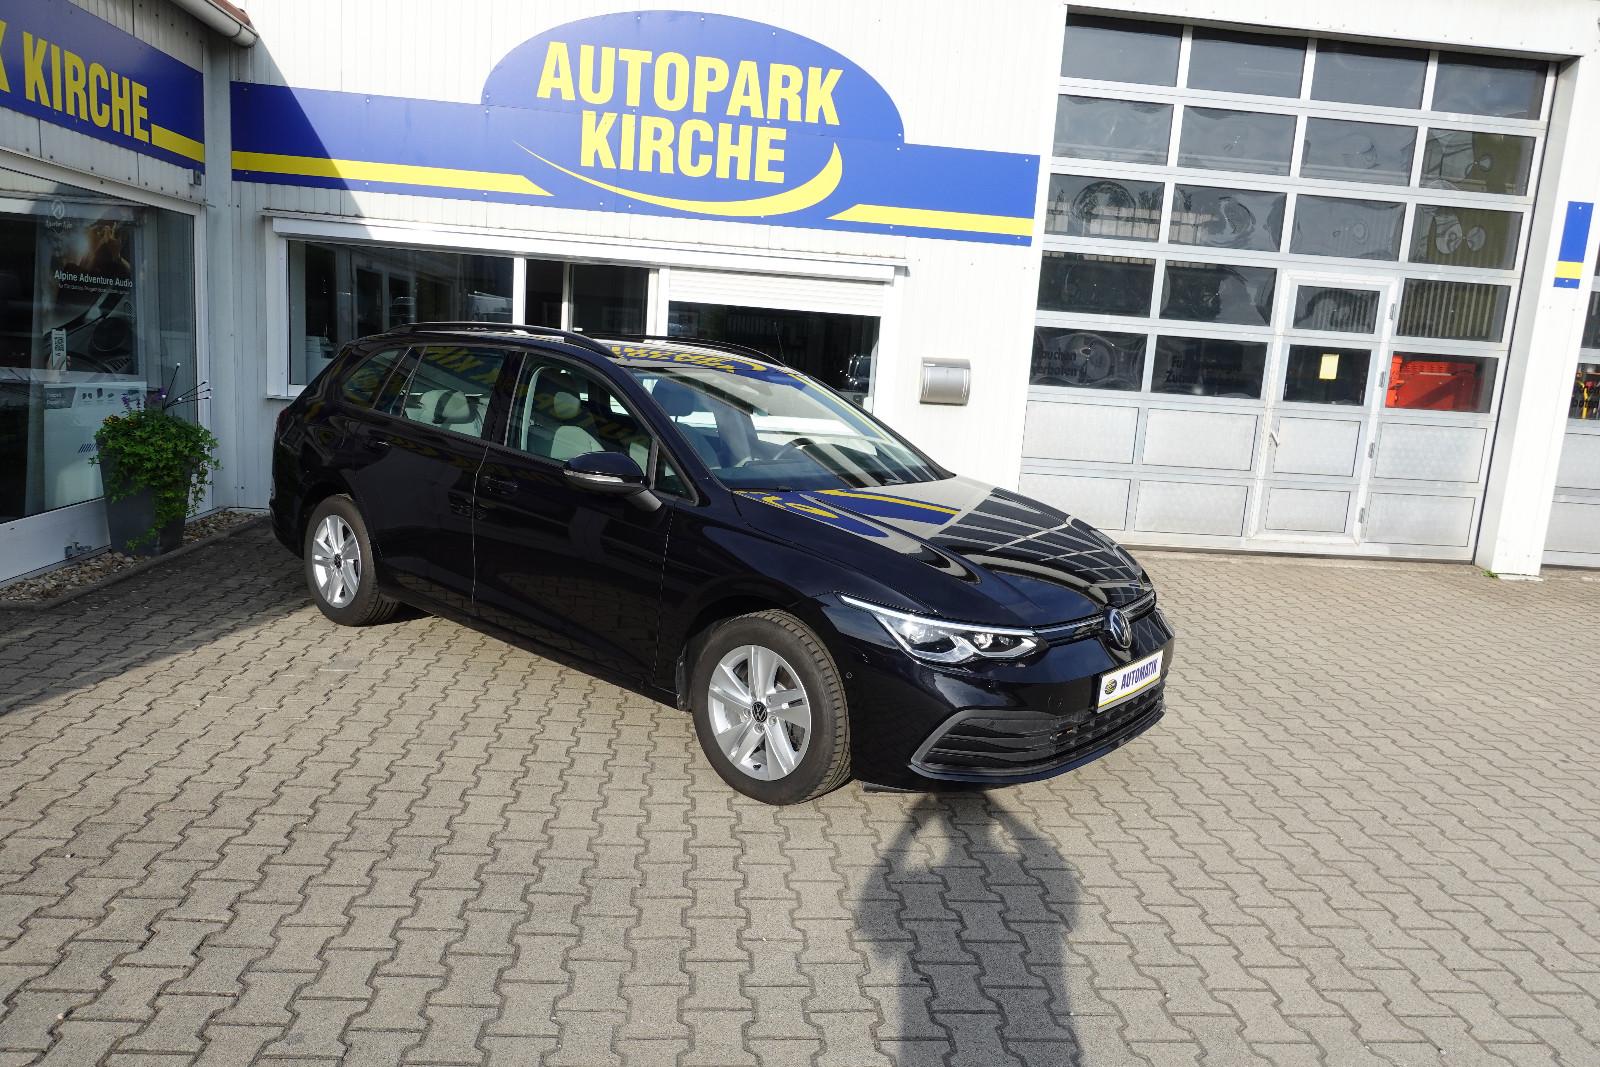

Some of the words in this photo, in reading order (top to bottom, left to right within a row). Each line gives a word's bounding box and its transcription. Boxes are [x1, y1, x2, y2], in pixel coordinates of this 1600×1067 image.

[22, 31, 149, 143] KIRCHE
[536, 41, 843, 126] AUTOPARK
[580, 110, 786, 184] KIRCHE
[54, 269, 78, 282] Alpine
[79, 273, 113, 286] Adventure
[114, 278, 133, 288] Audio
[1120, 657, 1159, 690] AUTOMATIK
